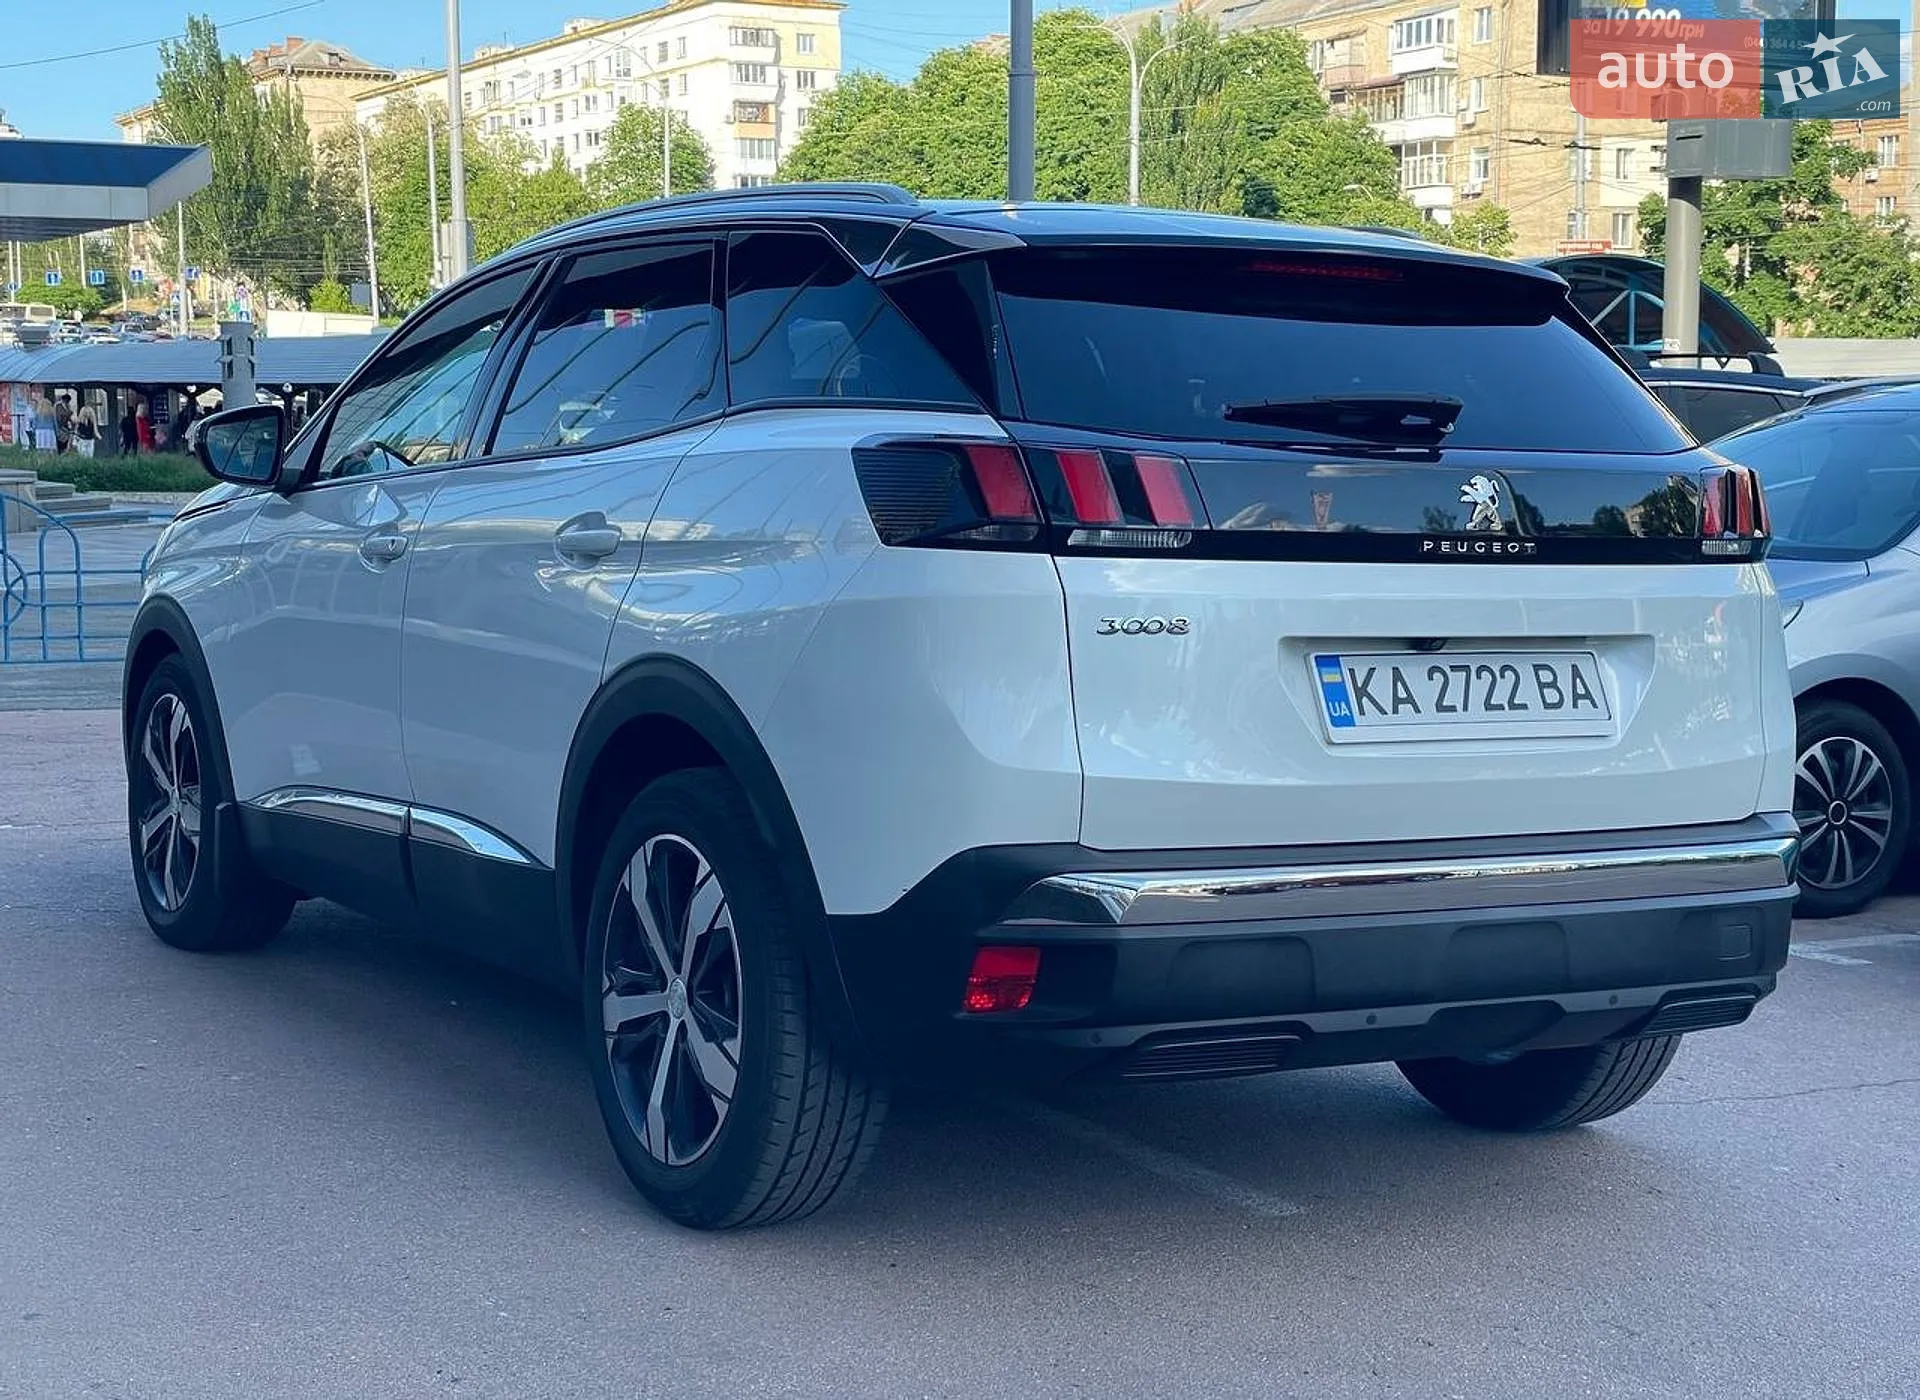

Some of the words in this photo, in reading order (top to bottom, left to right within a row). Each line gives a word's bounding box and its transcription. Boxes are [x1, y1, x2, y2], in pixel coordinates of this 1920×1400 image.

[1603, 8, 1630, 36] 19
[1634, 8, 1681, 39] 990
[1678, 23, 1705, 41] грн
[1422, 540, 1537, 554] PEUGEOT
[1096, 616, 1190, 636] 3008
[1348, 666, 1422, 717] KA
[1426, 662, 1529, 714] 2722
[1531, 662, 1600, 711] BA
[1329, 701, 1351, 719] UA
